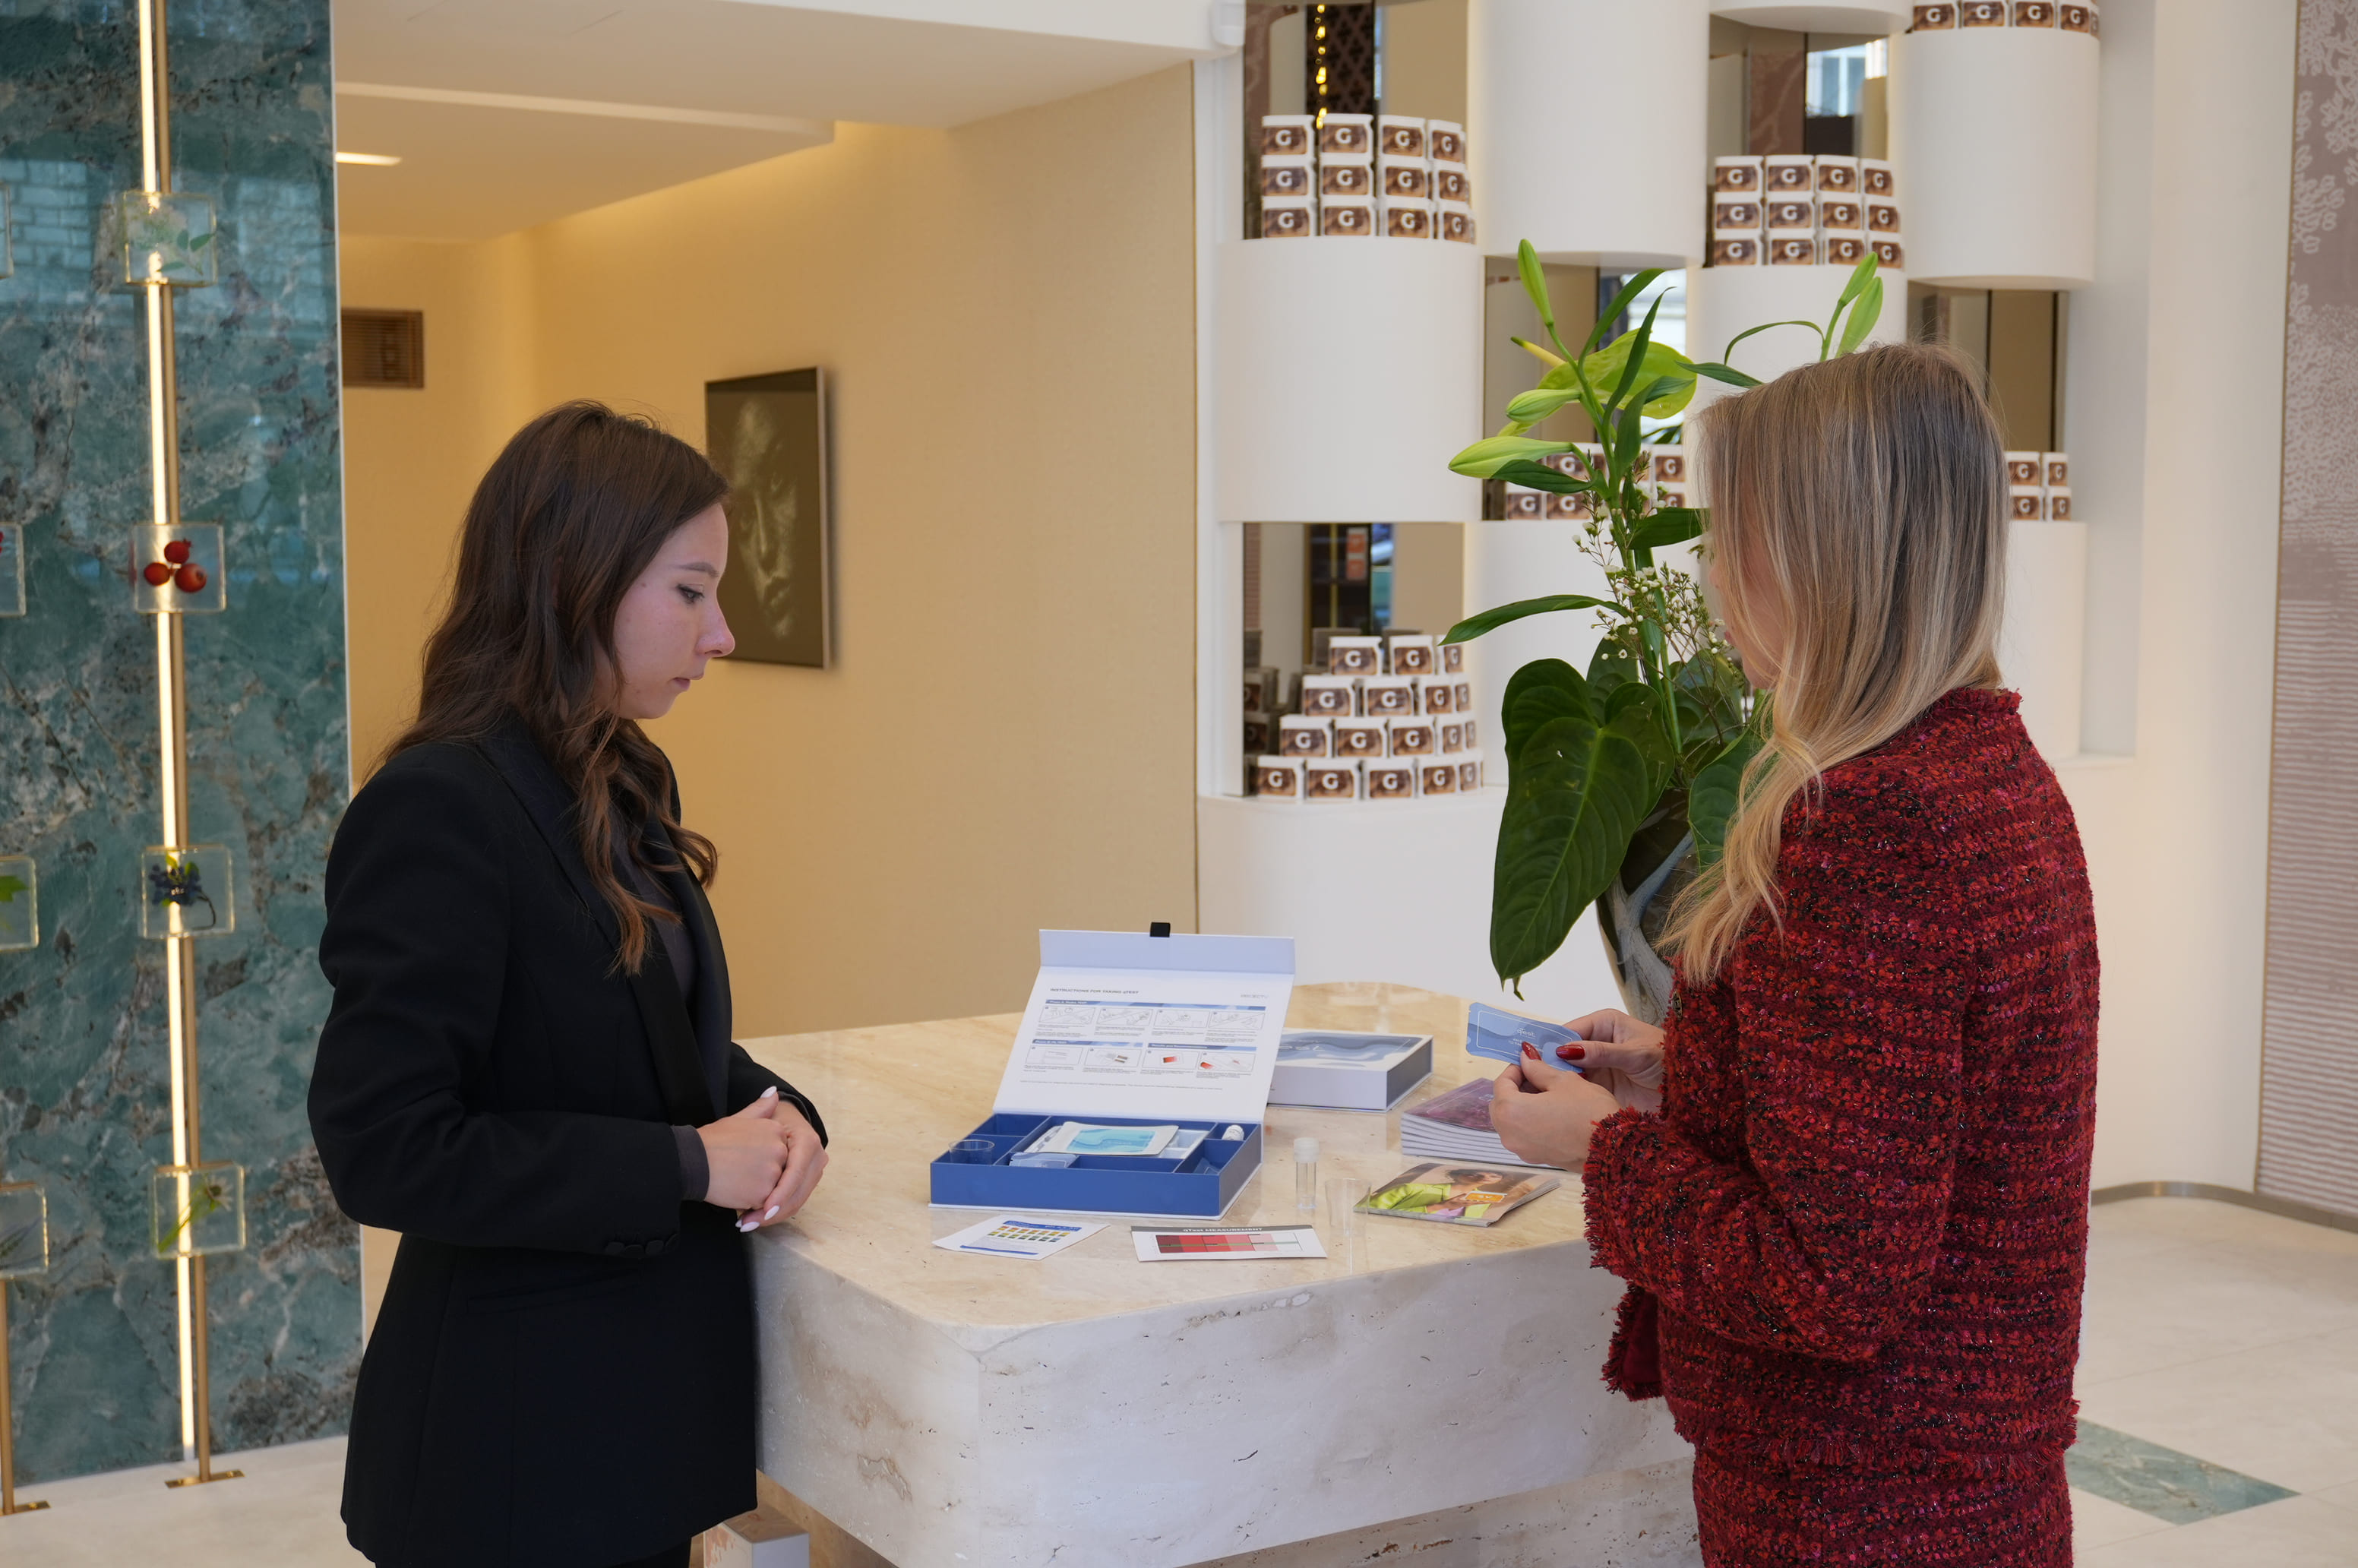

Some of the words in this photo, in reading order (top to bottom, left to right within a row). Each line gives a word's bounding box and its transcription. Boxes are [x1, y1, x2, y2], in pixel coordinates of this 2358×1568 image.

[1927, 8, 1940, 22] G
[1976, 5, 1990, 19] G
[2028, 5, 2040, 20] G
[2071, 10, 2080, 24] G
[1276, 130, 1291, 146] G
[1335, 128, 1351, 144] G
[1396, 131, 1410, 146] G
[1442, 136, 1452, 152] G
[1277, 171, 1291, 187] G
[1337, 170, 1352, 185] G
[1399, 172, 1411, 188] G
[1448, 175, 1457, 191] G
[1728, 169, 1743, 184] G
[1781, 169, 1796, 183] G
[1831, 169, 1843, 184] G
[1873, 173, 1883, 187] G
[1279, 212, 1294, 228] G
[1339, 210, 1354, 226] G
[1731, 207, 1744, 221] G
[1782, 205, 1797, 220] G
[1835, 207, 1848, 220] G
[1878, 210, 1889, 224] G
[1402, 213, 1414, 229] G
[1452, 217, 1462, 232] G
[1727, 243, 1742, 258] G
[1785, 242, 1800, 258] G
[1840, 242, 1852, 257] G
[1882, 245, 1892, 260] G
[1560, 457, 1575, 473] G
[1665, 459, 1676, 474] G
[2018, 463, 2028, 478] G
[1521, 496, 1535, 512] G
[1560, 496, 1575, 511] G
[2019, 498, 2030, 512] G
[1346, 650, 1361, 667] G
[1407, 650, 1419, 665] G
[1319, 691, 1334, 708] G
[1382, 691, 1396, 707] G
[1434, 690, 1444, 705] G
[1296, 732, 1311, 748] G
[1351, 732, 1366, 748] G
[1405, 731, 1419, 746] G
[1269, 771, 1282, 787] G
[1323, 773, 1339, 789] G
[1383, 773, 1398, 789] G
[1434, 770, 1445, 786] G
